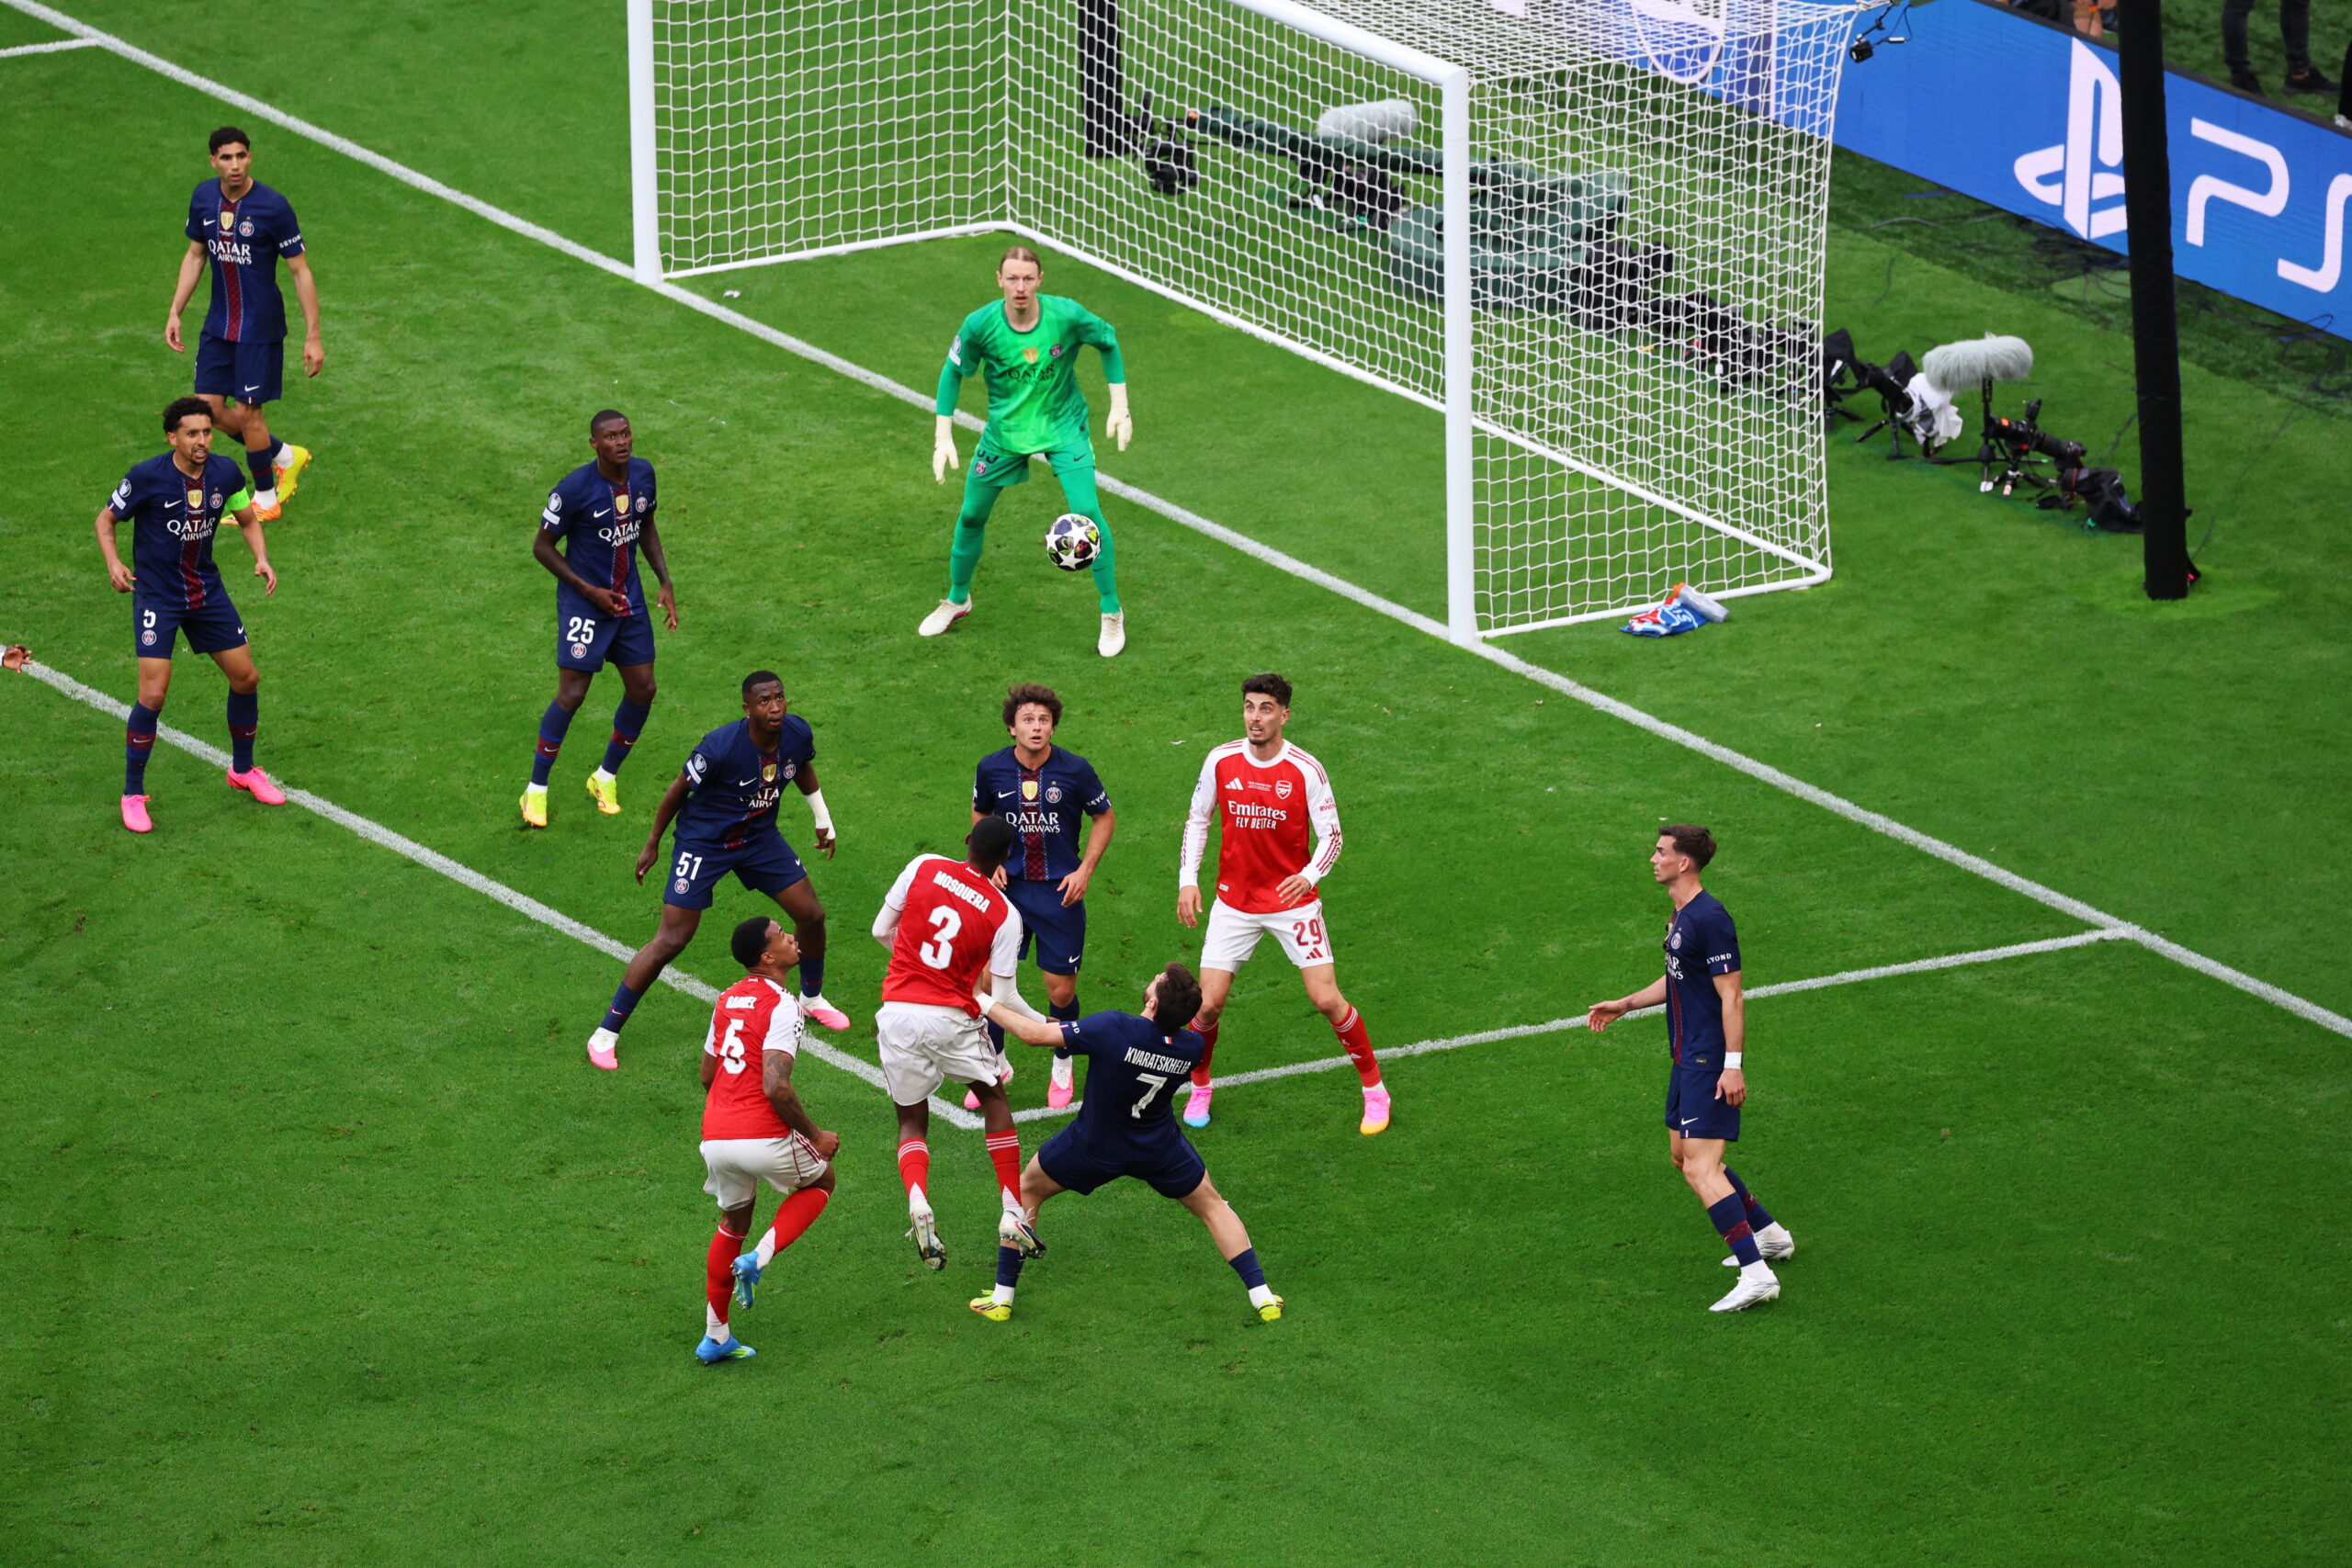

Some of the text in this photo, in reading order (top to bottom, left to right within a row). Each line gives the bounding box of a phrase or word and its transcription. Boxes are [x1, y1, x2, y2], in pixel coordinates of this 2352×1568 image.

[208, 239, 251, 256] QATAR
[278, 233, 301, 249] BEYON
[217, 254, 252, 265] AIRWAYS
[166, 517, 215, 536] QATAR
[180, 528, 212, 541] AIRWAYS
[598, 520, 641, 542] QATAR
[612, 530, 639, 547] AIRWAYS
[142, 609, 156, 628] 5
[566, 616, 595, 644] 25
[1006, 811, 1058, 827] QATAR
[1227, 800, 1287, 821] Emirates
[1018, 825, 1060, 834] AIRWAYS
[1236, 817, 1277, 830] FLY BETTER
[675, 852, 703, 881] 51
[933, 871, 990, 913] MOSQUERA
[920, 905, 962, 970] 3
[1293, 919, 1323, 946] 29
[1131, 1073, 1168, 1119] 7
